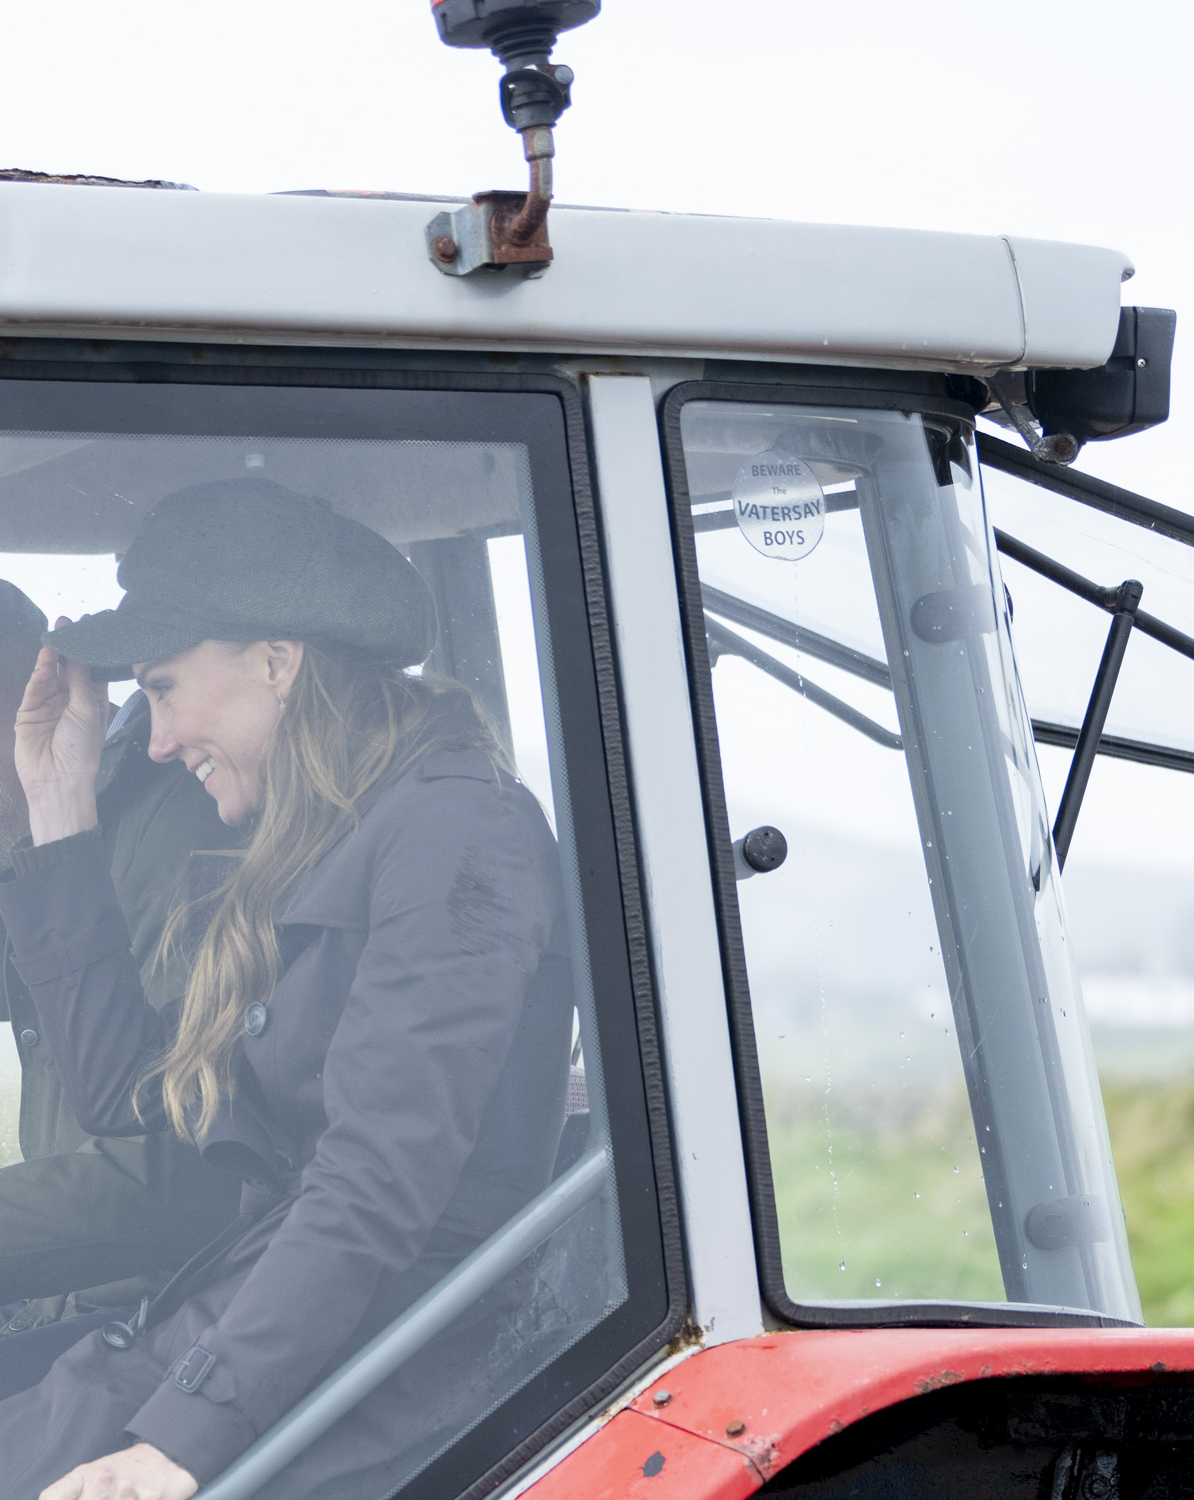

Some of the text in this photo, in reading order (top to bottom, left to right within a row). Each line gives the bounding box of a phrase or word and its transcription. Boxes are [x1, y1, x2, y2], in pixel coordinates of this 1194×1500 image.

[751, 463, 802, 477] BEWARE
[771, 486, 787, 495] The
[737, 499, 822, 522] VATERSAY
[763, 530, 805, 546] BOYS
